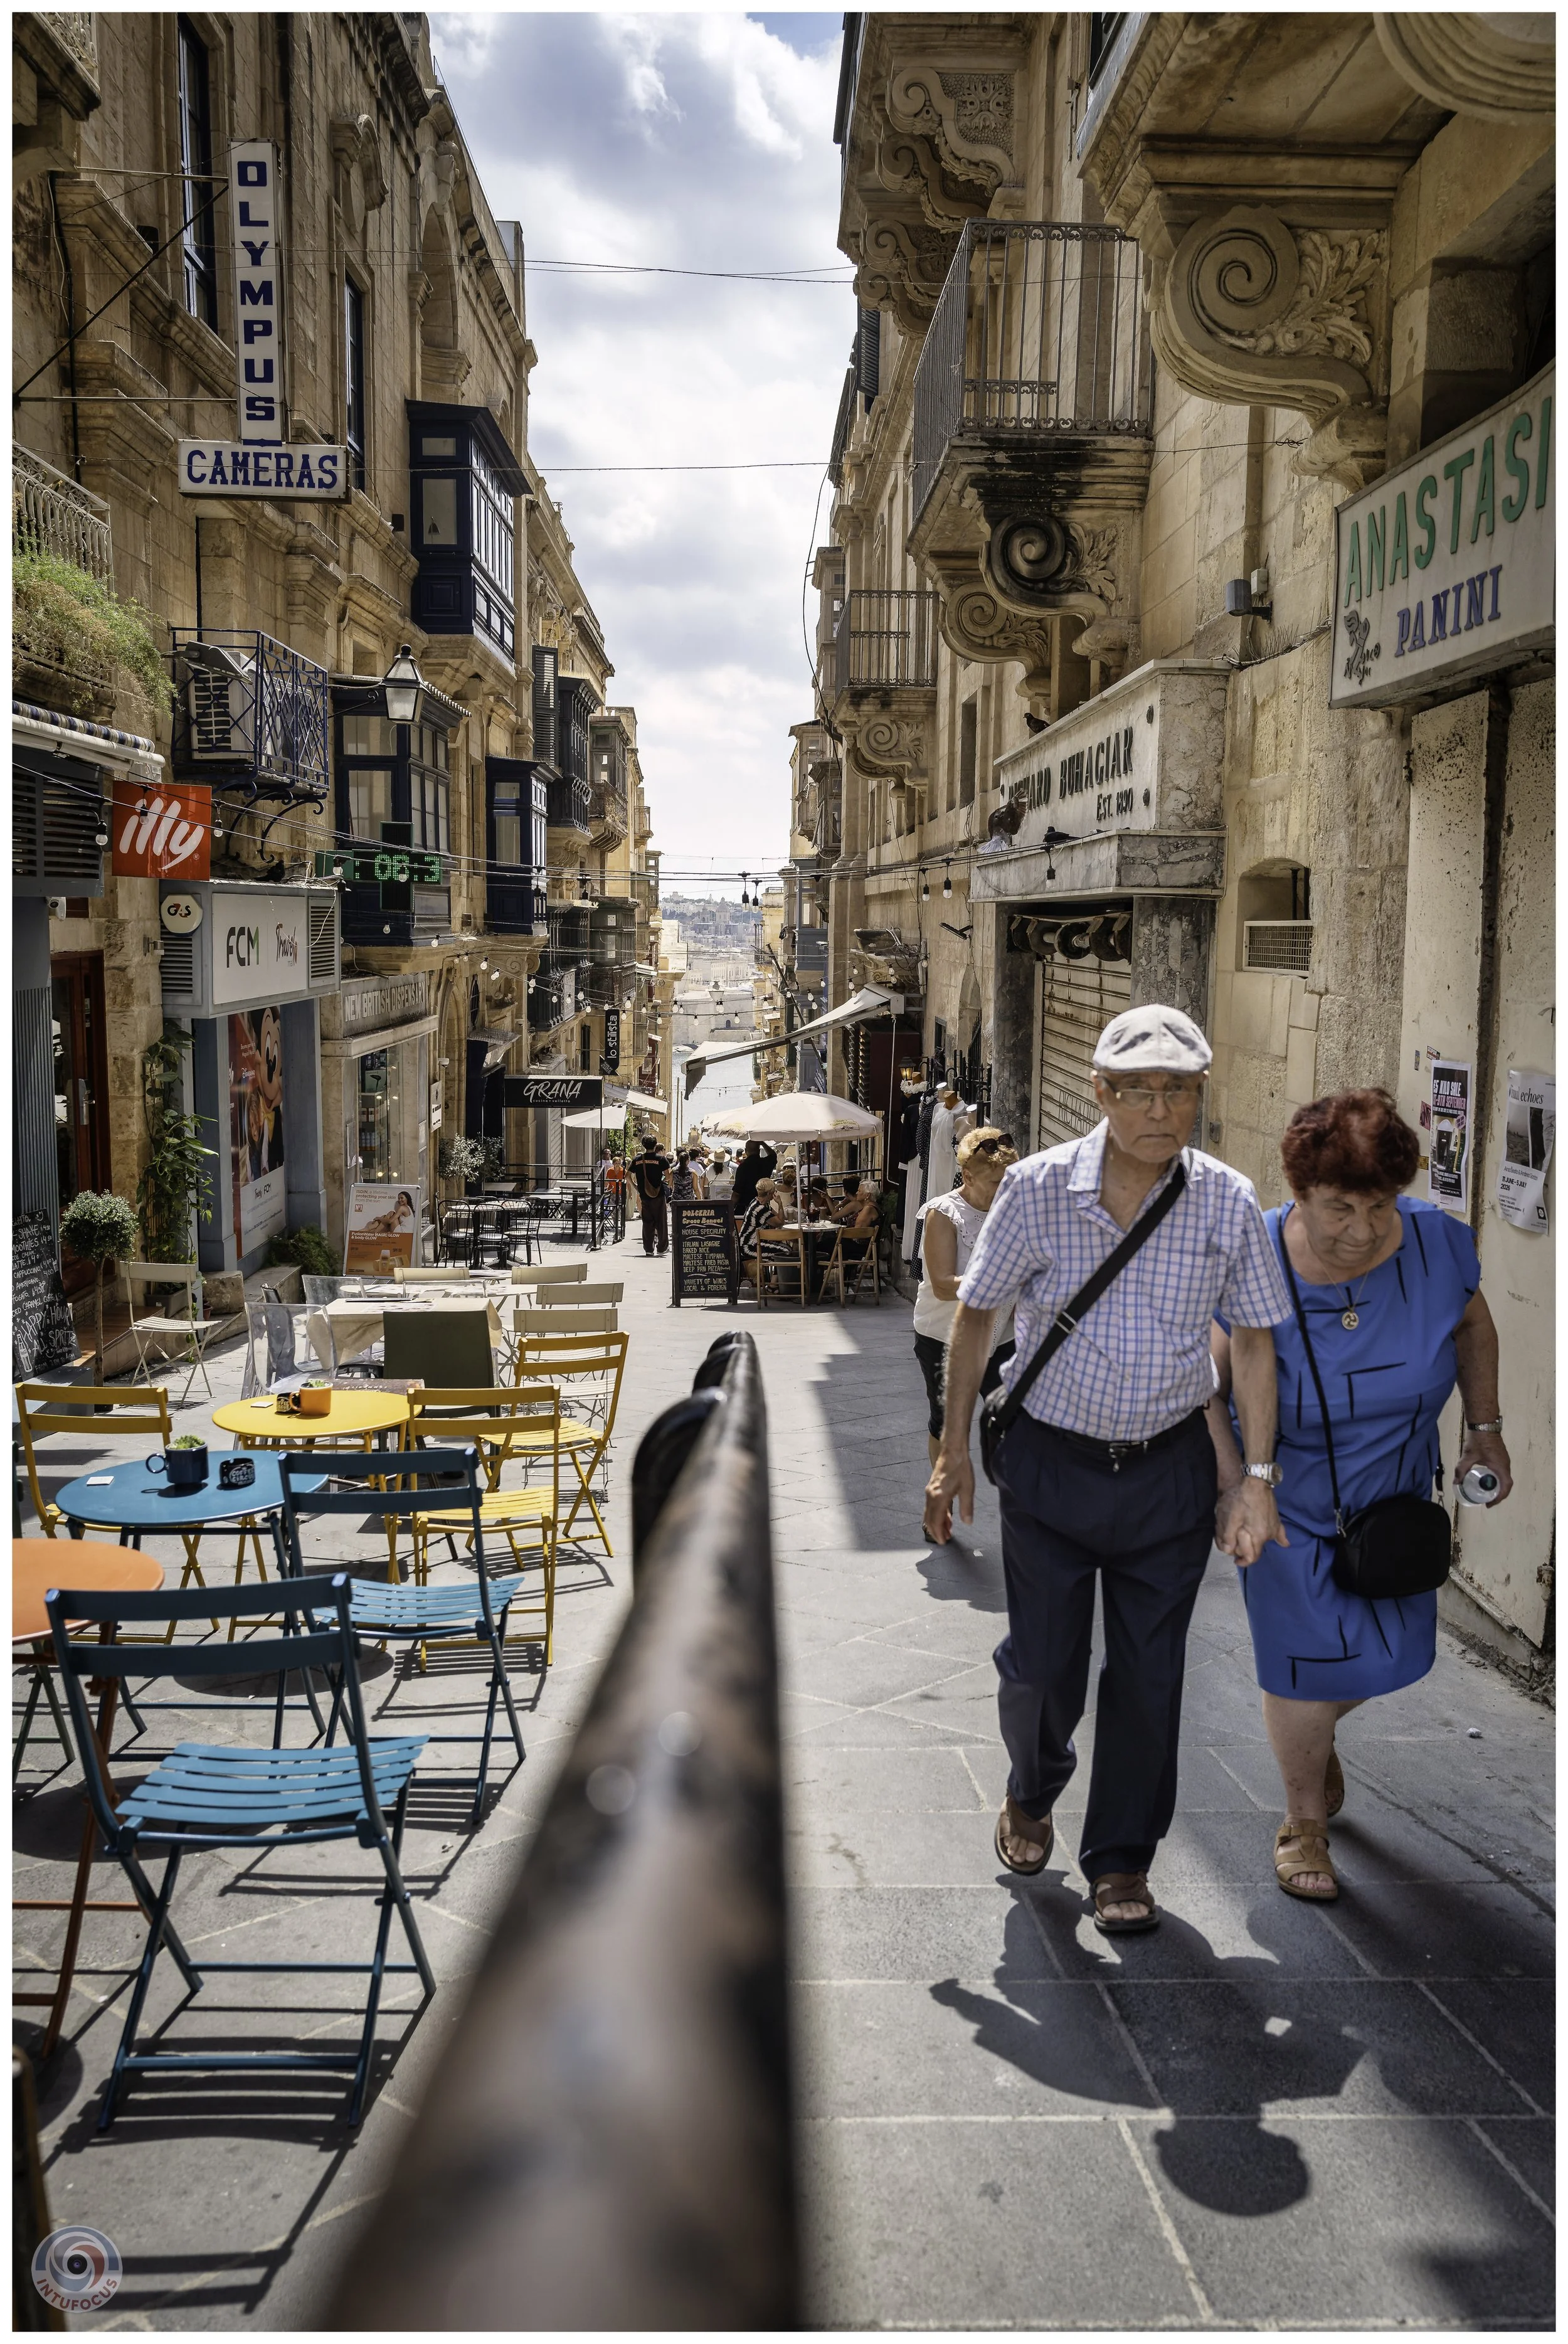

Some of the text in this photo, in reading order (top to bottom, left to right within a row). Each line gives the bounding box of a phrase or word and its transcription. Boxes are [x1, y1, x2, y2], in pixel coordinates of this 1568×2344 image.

[237, 161, 275, 420] OLYMPUS
[188, 449, 338, 489] CAMERAS
[1343, 396, 1552, 608] ANASTASI
[1394, 565, 1502, 658] PANINI
[1059, 726, 1133, 800] BUHAGIAR
[119, 797, 205, 870] illy
[167, 903, 192, 918] G4S
[226, 926, 260, 968] FCM
[344, 981, 425, 1022] NEW BRITISH DISPENSARY
[607, 1015, 617, 1058] lo stilista
[523, 1080, 583, 1103] GRANA
[1439, 1080, 1450, 1096] KILO
[1450, 1081, 1462, 1097] SALE
[1446, 1096, 1466, 1110] SEPTEMBER
[1520, 1088, 1544, 1105] echoes
[1500, 1183, 1511, 1191] 2026
[22, 1297, 43, 1311] CARAMEL
[18, 1305, 71, 1350] HAPPY HOUR
[32, 1337, 48, 1357] ALL
